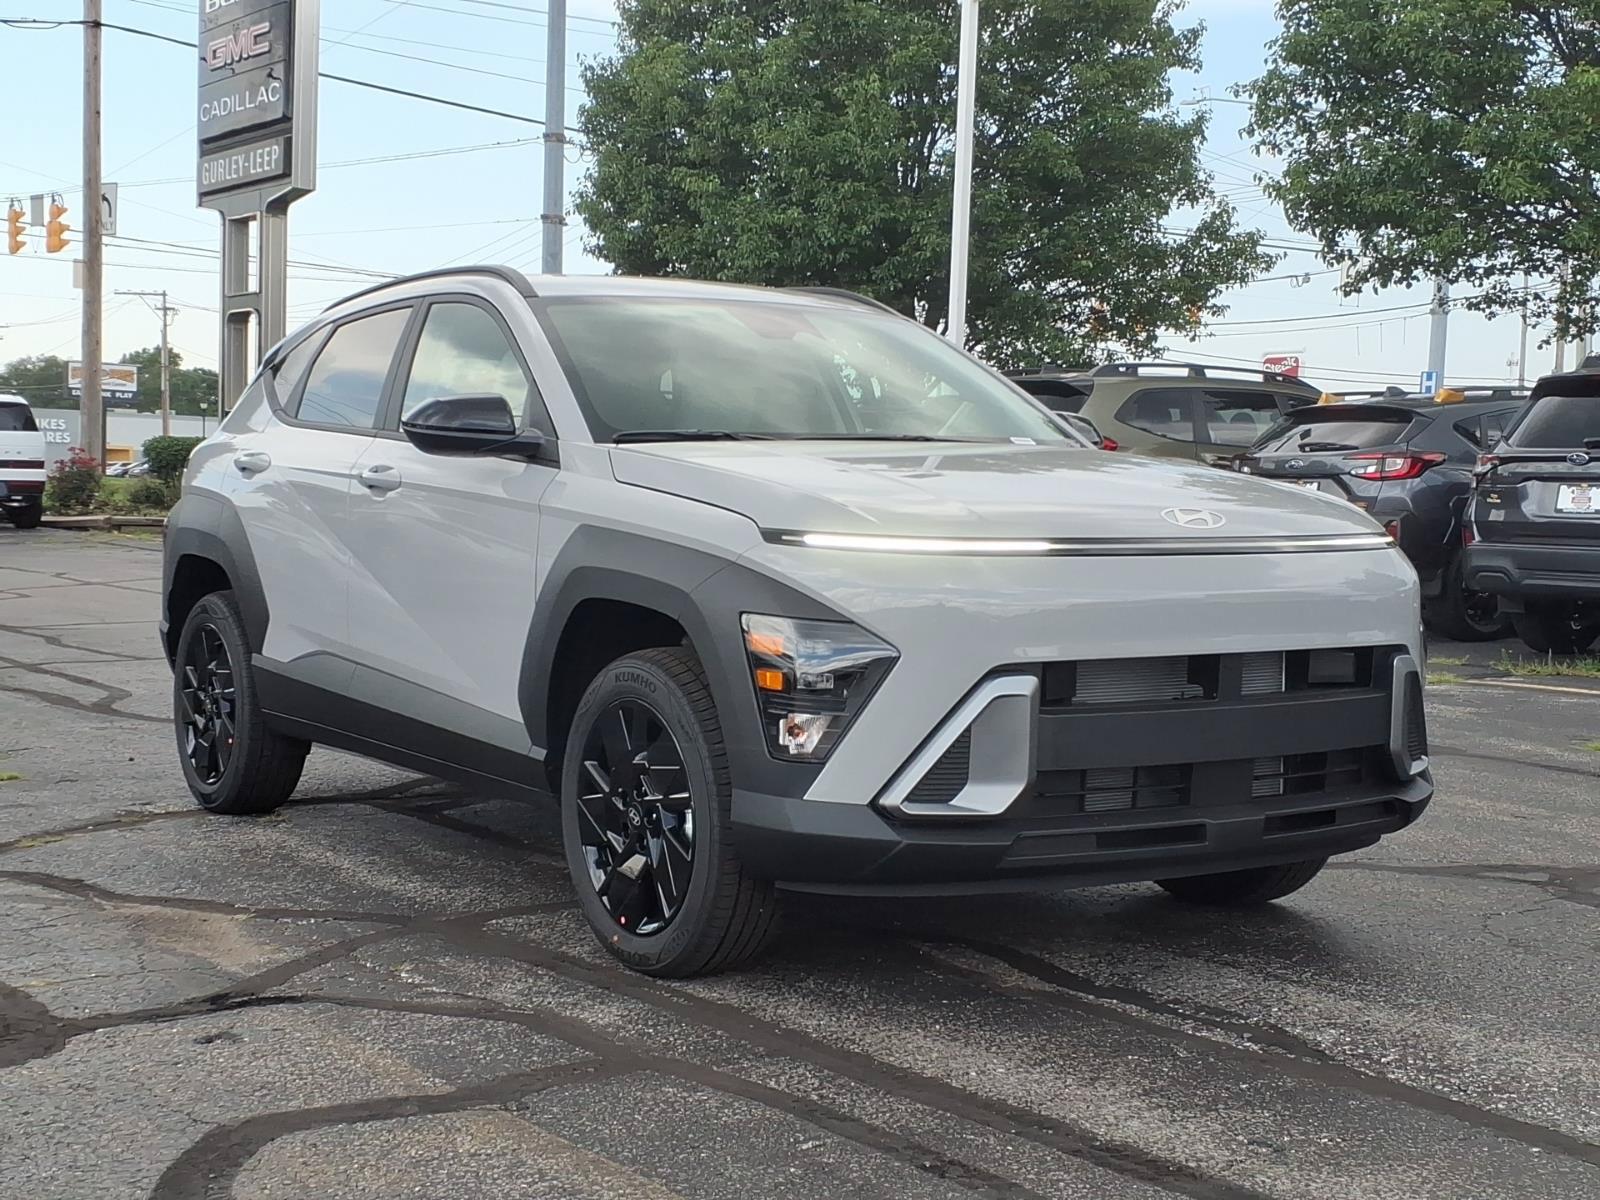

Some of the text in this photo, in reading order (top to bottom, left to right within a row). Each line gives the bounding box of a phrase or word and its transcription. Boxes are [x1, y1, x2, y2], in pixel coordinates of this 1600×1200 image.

[207, 22, 270, 71] GMC
[200, 82, 280, 122] CADILLAC
[202, 145, 279, 185] GURLEY-LEEP
[35, 418, 66, 430] IKES
[46, 431, 71, 443] RES
[615, 671, 657, 694] KUMHO
